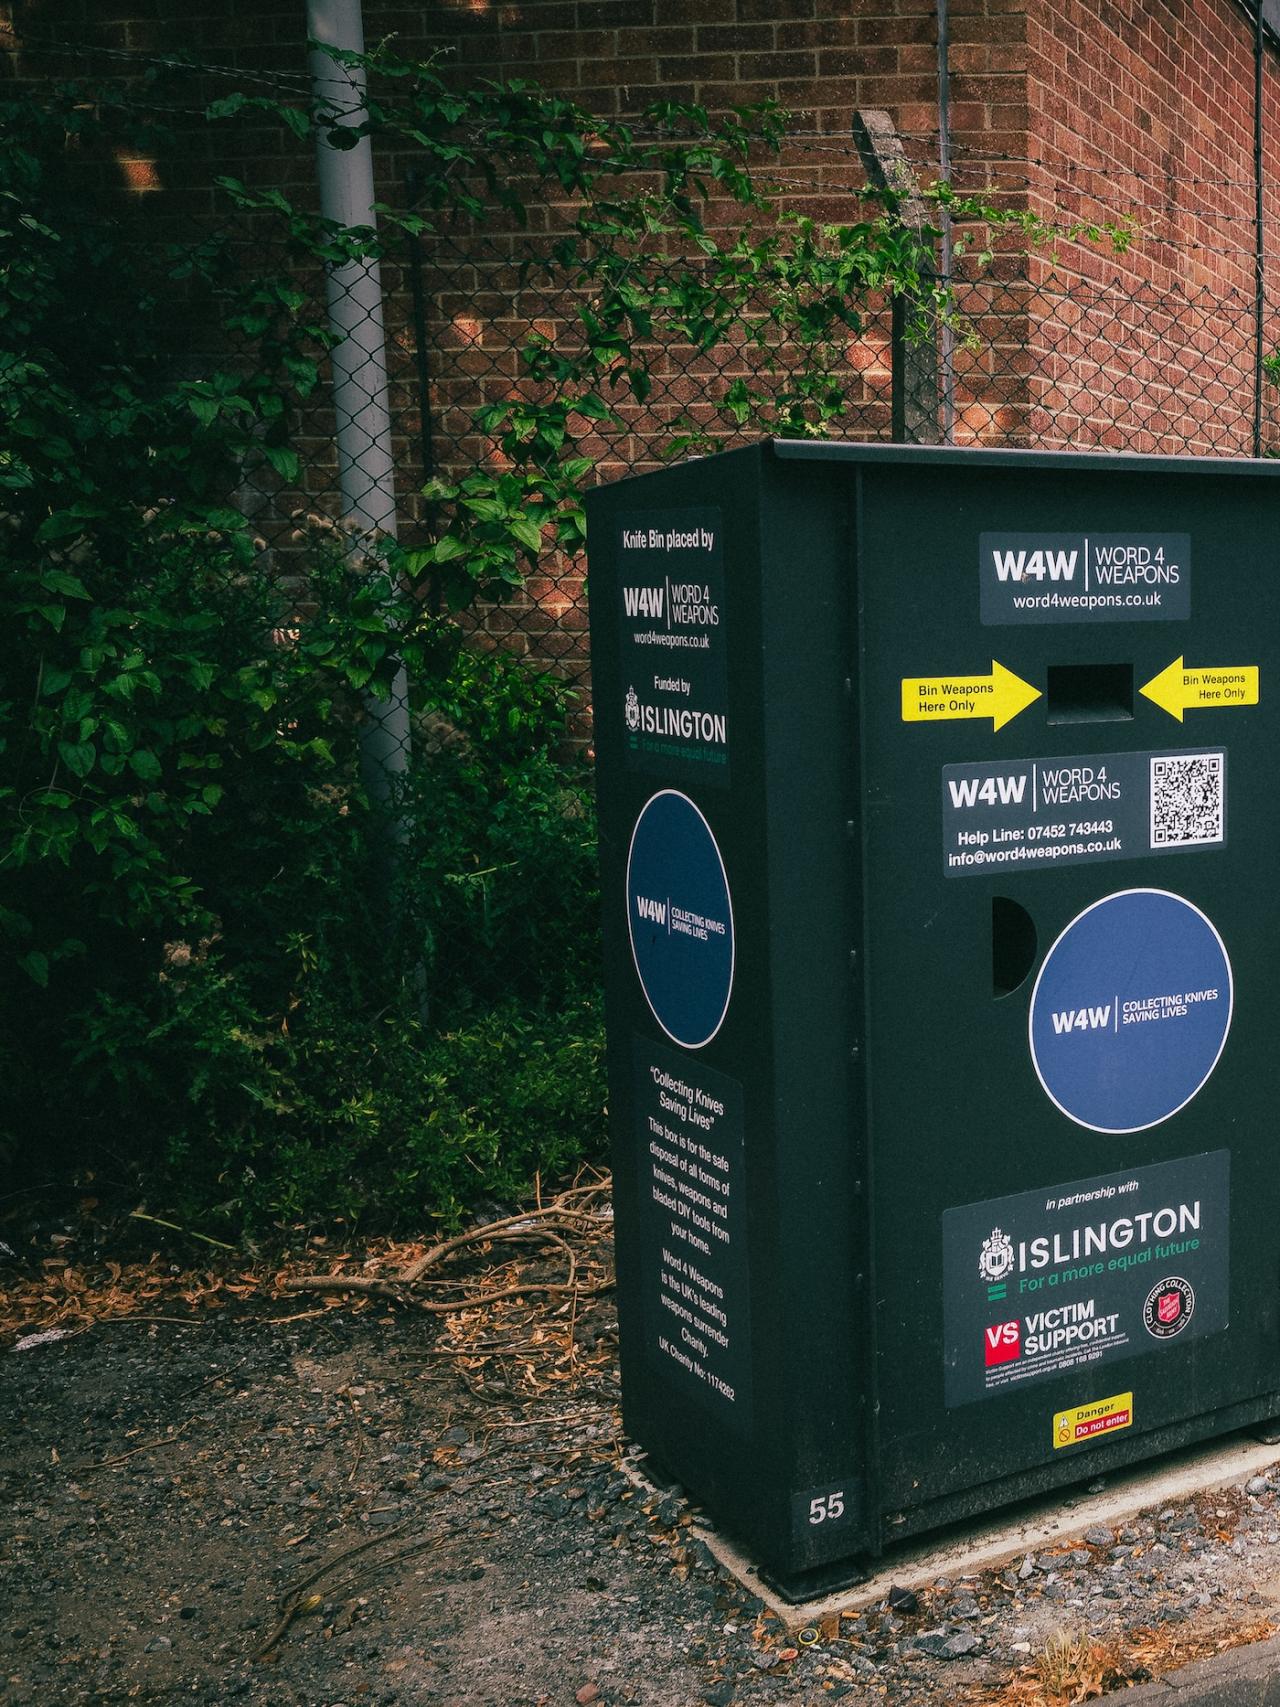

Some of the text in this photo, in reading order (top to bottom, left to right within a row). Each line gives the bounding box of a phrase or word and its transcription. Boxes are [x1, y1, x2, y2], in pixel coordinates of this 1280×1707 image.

[623, 528, 714, 552] Knife Bin placed by
[992, 550, 1078, 582] W4W
[1095, 546, 1164, 566] WORD 4
[1095, 565, 1180, 584] WEAPONS
[623, 587, 664, 618] W4W
[671, 584, 710, 604] WORD 4
[1013, 592, 1162, 610] word4weapons.co.uk
[672, 604, 719, 626] WEAPONS
[634, 630, 710, 649] word4weapons.co.uk
[654, 676, 690, 696] Funded by
[918, 683, 994, 697] Bin Weapons
[1183, 674, 1246, 686] Bin Weapons
[1199, 688, 1246, 700] Here Only
[918, 700, 975, 714] Here Only
[641, 705, 726, 744] ISLINGTON
[1042, 766, 1107, 788] WORD 4
[948, 776, 1026, 808] W4W
[1042, 782, 1121, 804] WEAPONS
[958, 820, 1113, 846] Help Line: 07452 743443
[948, 837, 1122, 867] info@word4weapons.co.uk
[636, 896, 666, 925] W4W
[672, 907, 726, 935] COLLECTING KNIVES
[672, 919, 708, 940] SAVING LIVES
[1122, 988, 1218, 1013] COLLECTING KNIVES
[1122, 1005, 1188, 1024] SAVING LIVES
[1052, 1006, 1110, 1034] W4W
[660, 1090, 686, 1122] Saving
[696, 1088, 724, 1116] Knives
[648, 1116, 729, 1173] This box is for the safe
[650, 1141, 730, 1197] disposal of all forms of
[653, 1164, 728, 1220] knives, weapons and
[1046, 1180, 1139, 1210] in partnership with
[652, 1186, 730, 1244] bladed DIY tools from
[670, 1222, 711, 1256] your home.
[1018, 1200, 1200, 1272] ISLINGTON
[662, 1248, 724, 1300] Word 4 Weapons
[1020, 1275, 1044, 1294] For
[1048, 1274, 1058, 1286] a
[1062, 1262, 1104, 1283] more
[1108, 1248, 1151, 1272] equal
[1155, 1237, 1200, 1260] future
[661, 1269, 668, 1284] is
[668, 1274, 680, 1292] the
[700, 1295, 728, 1328] leading
[1146, 1284, 1166, 1324] CLOTHING
[1166, 1280, 1192, 1313] COLLECTION
[660, 1294, 729, 1348] weapons surrender
[1024, 1299, 1094, 1336] VICTIM
[680, 1327, 708, 1358] Charity.
[986, 1321, 1019, 1349] VS
[1024, 1314, 1119, 1356] SUPPORT
[658, 1336, 670, 1354] UK
[670, 1344, 694, 1372] Charity
[694, 1361, 706, 1380] No:
[1076, 1403, 1114, 1420] Danger
[1076, 1414, 1128, 1436] Do not enter
[808, 1491, 844, 1524] 55
